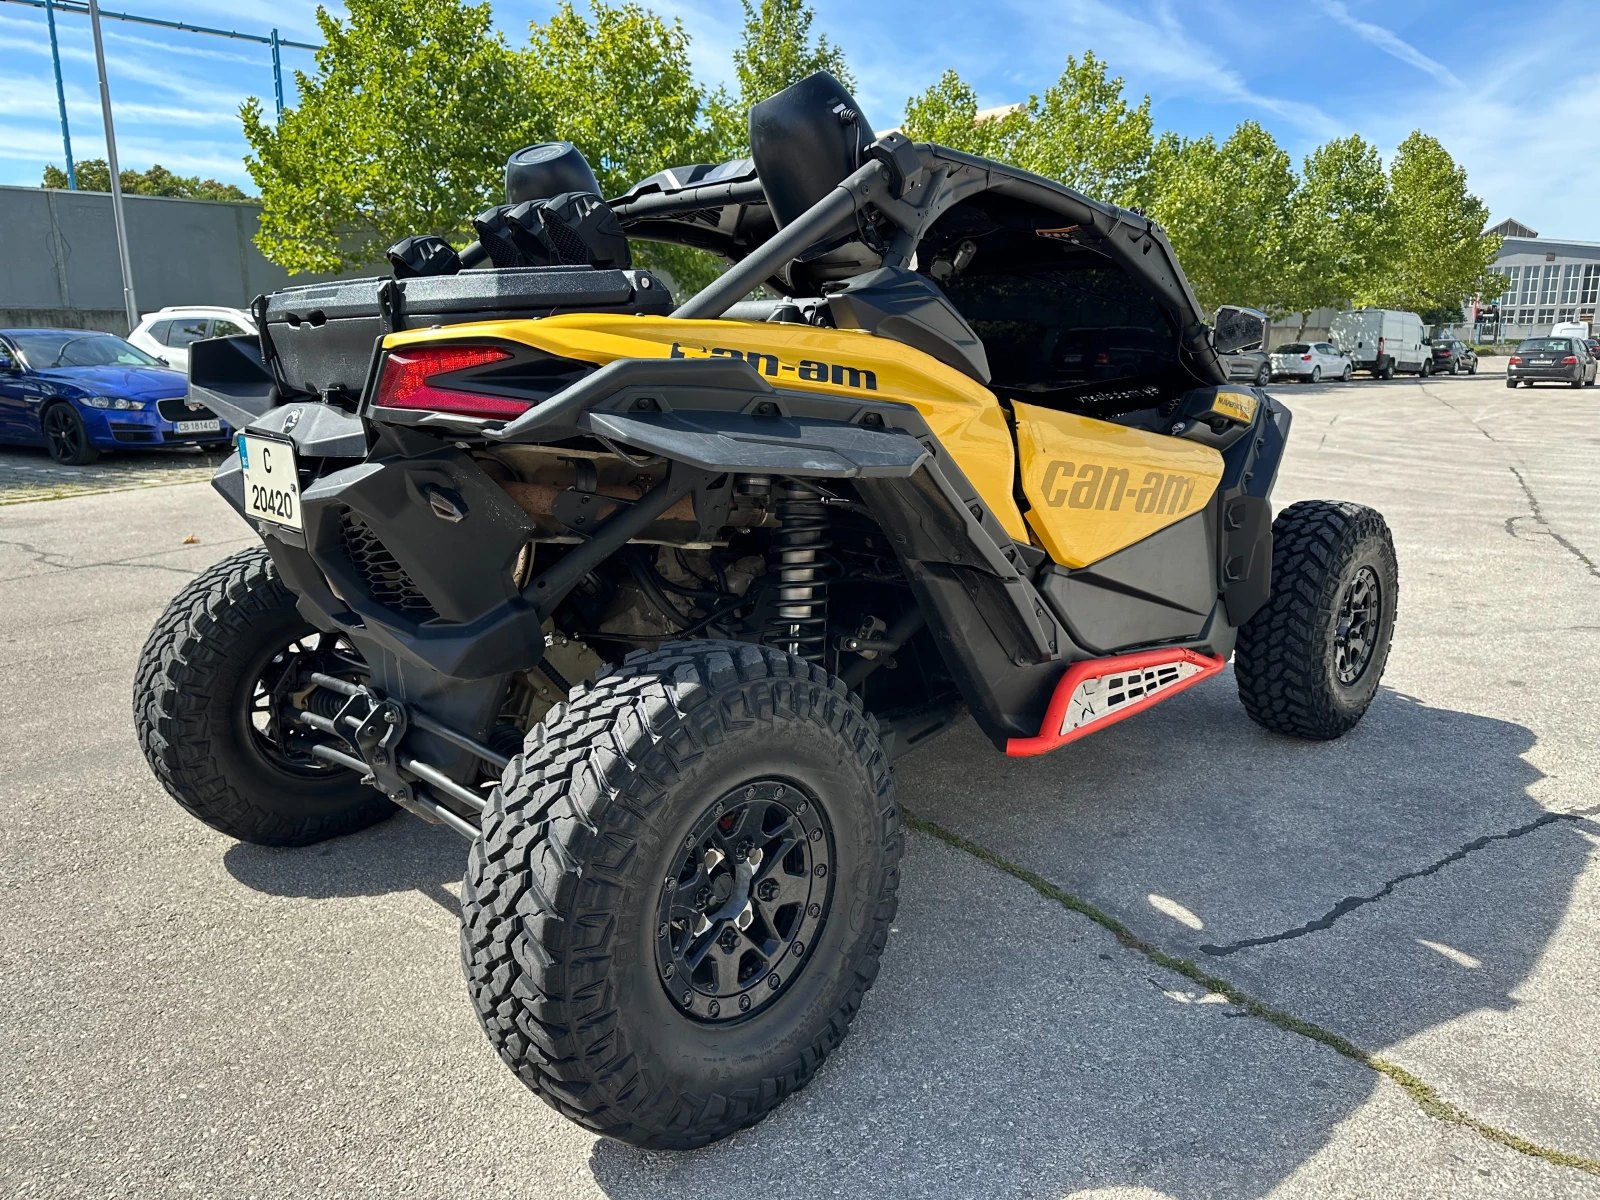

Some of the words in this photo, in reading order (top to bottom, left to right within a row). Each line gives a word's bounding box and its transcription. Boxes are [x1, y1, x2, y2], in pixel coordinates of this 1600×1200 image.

[179, 422, 189, 431] CB
[191, 422, 208, 430] 1814
[263, 447, 272, 473] C
[252, 484, 293, 519] 20420
[1041, 459, 1195, 515] can-am
